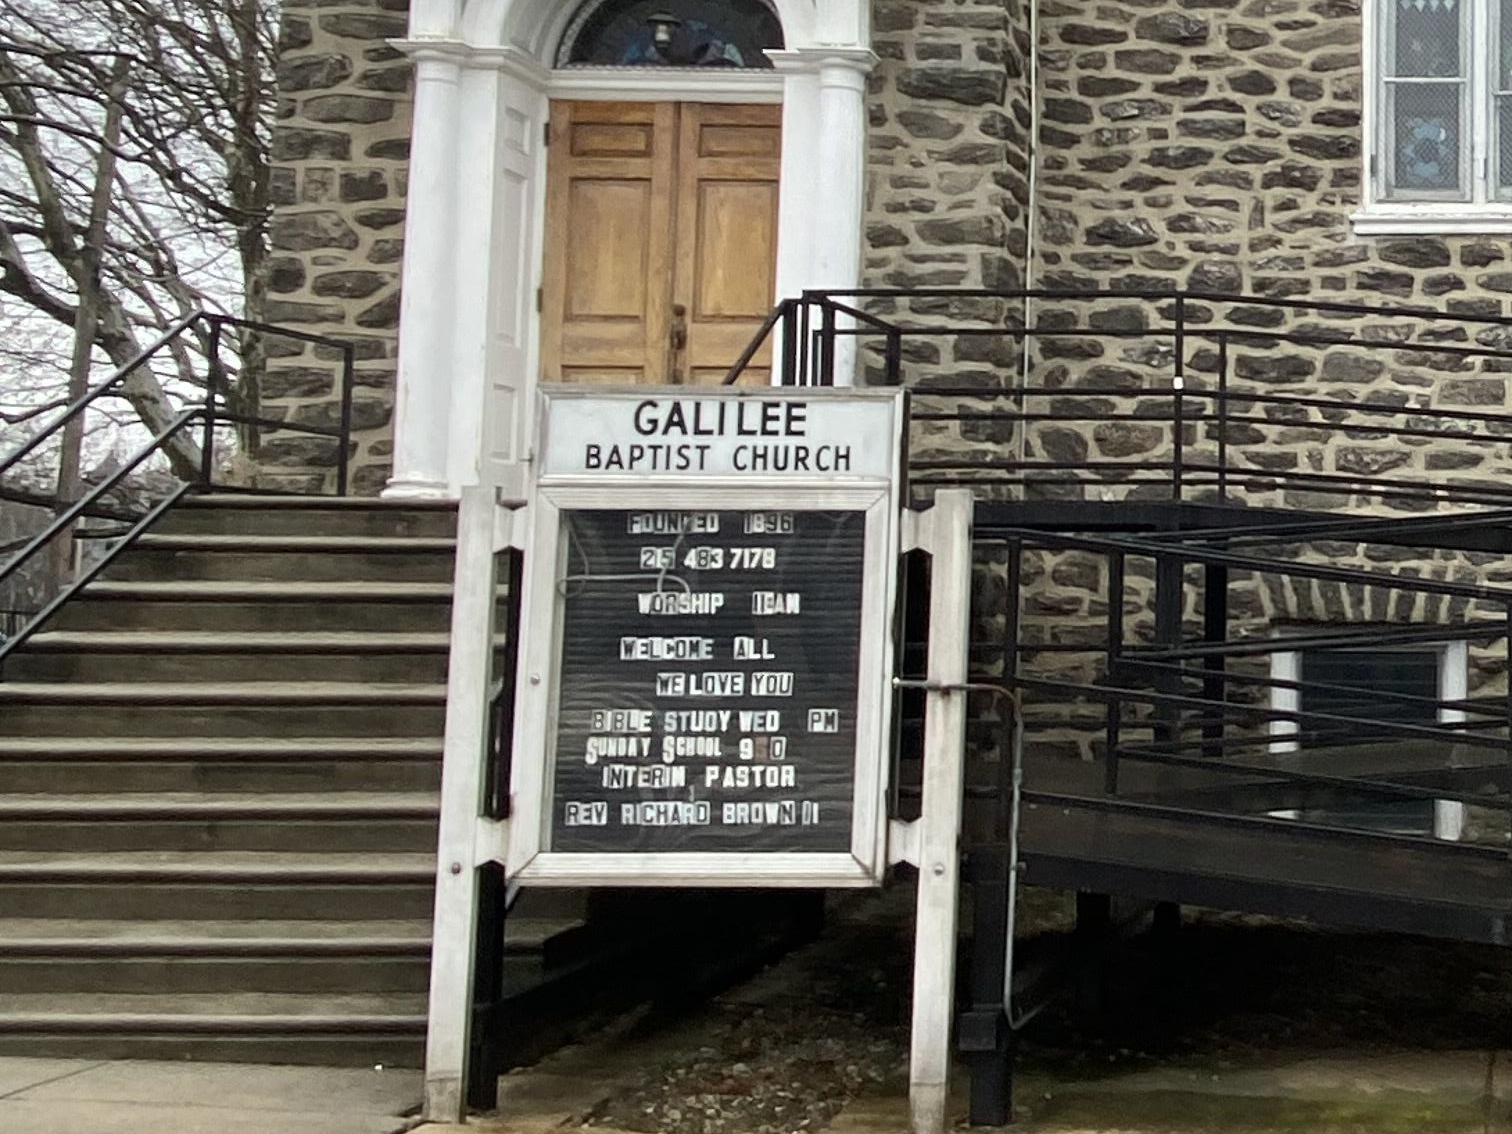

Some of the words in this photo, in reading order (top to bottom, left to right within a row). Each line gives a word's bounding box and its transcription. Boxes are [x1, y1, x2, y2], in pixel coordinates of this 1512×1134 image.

[634, 401, 806, 436] GALILEE
[585, 444, 711, 470] BAPTIST
[732, 445, 851, 471] CHURCH
[683, 547, 724, 569] 483
[638, 593, 724, 614] WORSHIP
[620, 637, 715, 660] WELCOME
[733, 637, 775, 659] ALL
[656, 672, 685, 696] WE
[689, 672, 744, 696] LOVE
[751, 672, 793, 696] YOU
[592, 709, 653, 732] BIBLE
[664, 710, 732, 732] STUDY
[739, 711, 780, 732] WED
[807, 709, 839, 732] PM
[602, 764, 686, 788] INTERIM
[705, 765, 795, 788] PASTOR
[565, 801, 607, 825] REV
[621, 801, 710, 825] RICHARD
[722, 800, 796, 824] BROWN
